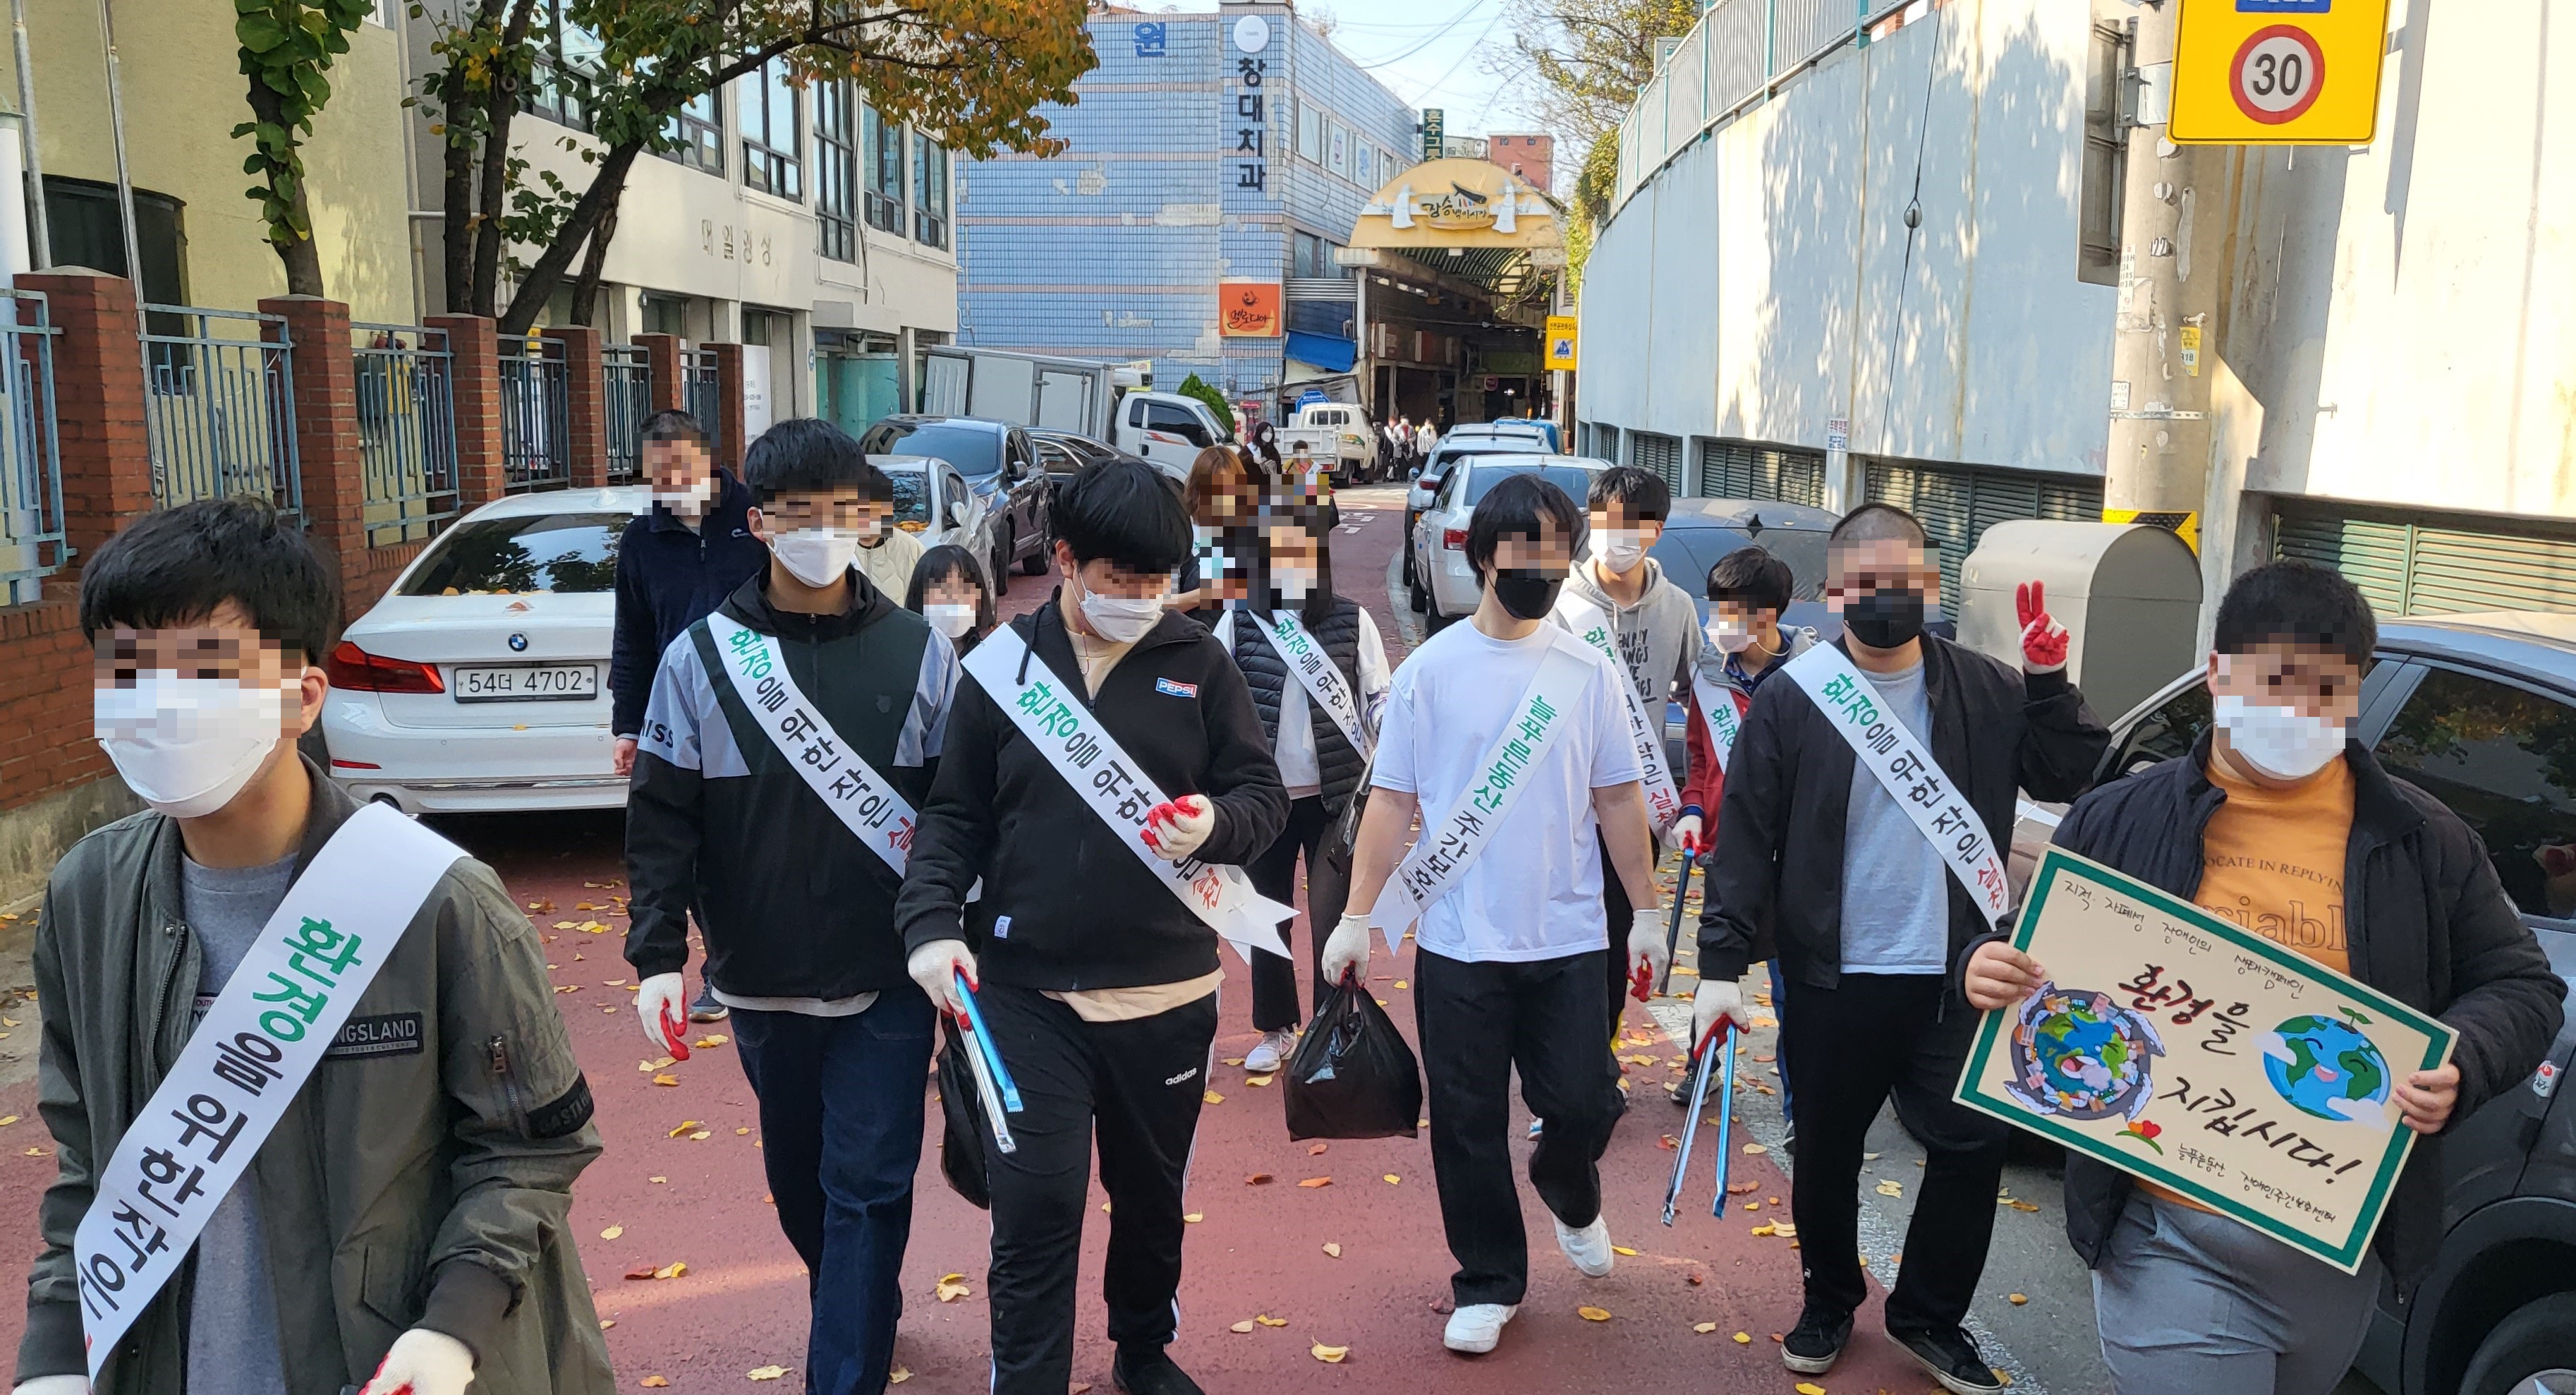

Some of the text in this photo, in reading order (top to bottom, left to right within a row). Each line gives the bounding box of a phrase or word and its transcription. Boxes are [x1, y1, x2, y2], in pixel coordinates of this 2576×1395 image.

[1132, 22, 1166, 57] 원
[2252, 53, 2302, 96] 30
[1238, 57, 1267, 191] 창대치과
[468, 670, 582, 693] 54더 4702
[1159, 681, 1194, 695] PEPSI
[1272, 617, 1324, 676] 환경을
[1316, 670, 1348, 711] 위한
[729, 628, 916, 863] 환경을 위한 작은 실
[1473, 694, 1557, 815] 늘푸른동산
[1711, 704, 1738, 749] 환경
[1016, 680, 1103, 770] 환경을
[1093, 759, 1152, 826] 위한
[1191, 866, 1224, 910] 실천
[1821, 672, 2006, 911] 환경을 위한 작은 실천
[2259, 859, 2277, 871] IN
[2104, 896, 2145, 932] 자폐성
[2161, 922, 2212, 955] 장애인의
[2234, 953, 2304, 999] 생태캠페인
[2118, 962, 2251, 1056] 환경을
[79, 914, 363, 1322] 환경을 위한 작은
[1165, 1067, 1197, 1085] adidas
[2158, 1075, 2363, 1185] 지킵시다!
[2178, 1142, 2226, 1177] 늘푸른동산
